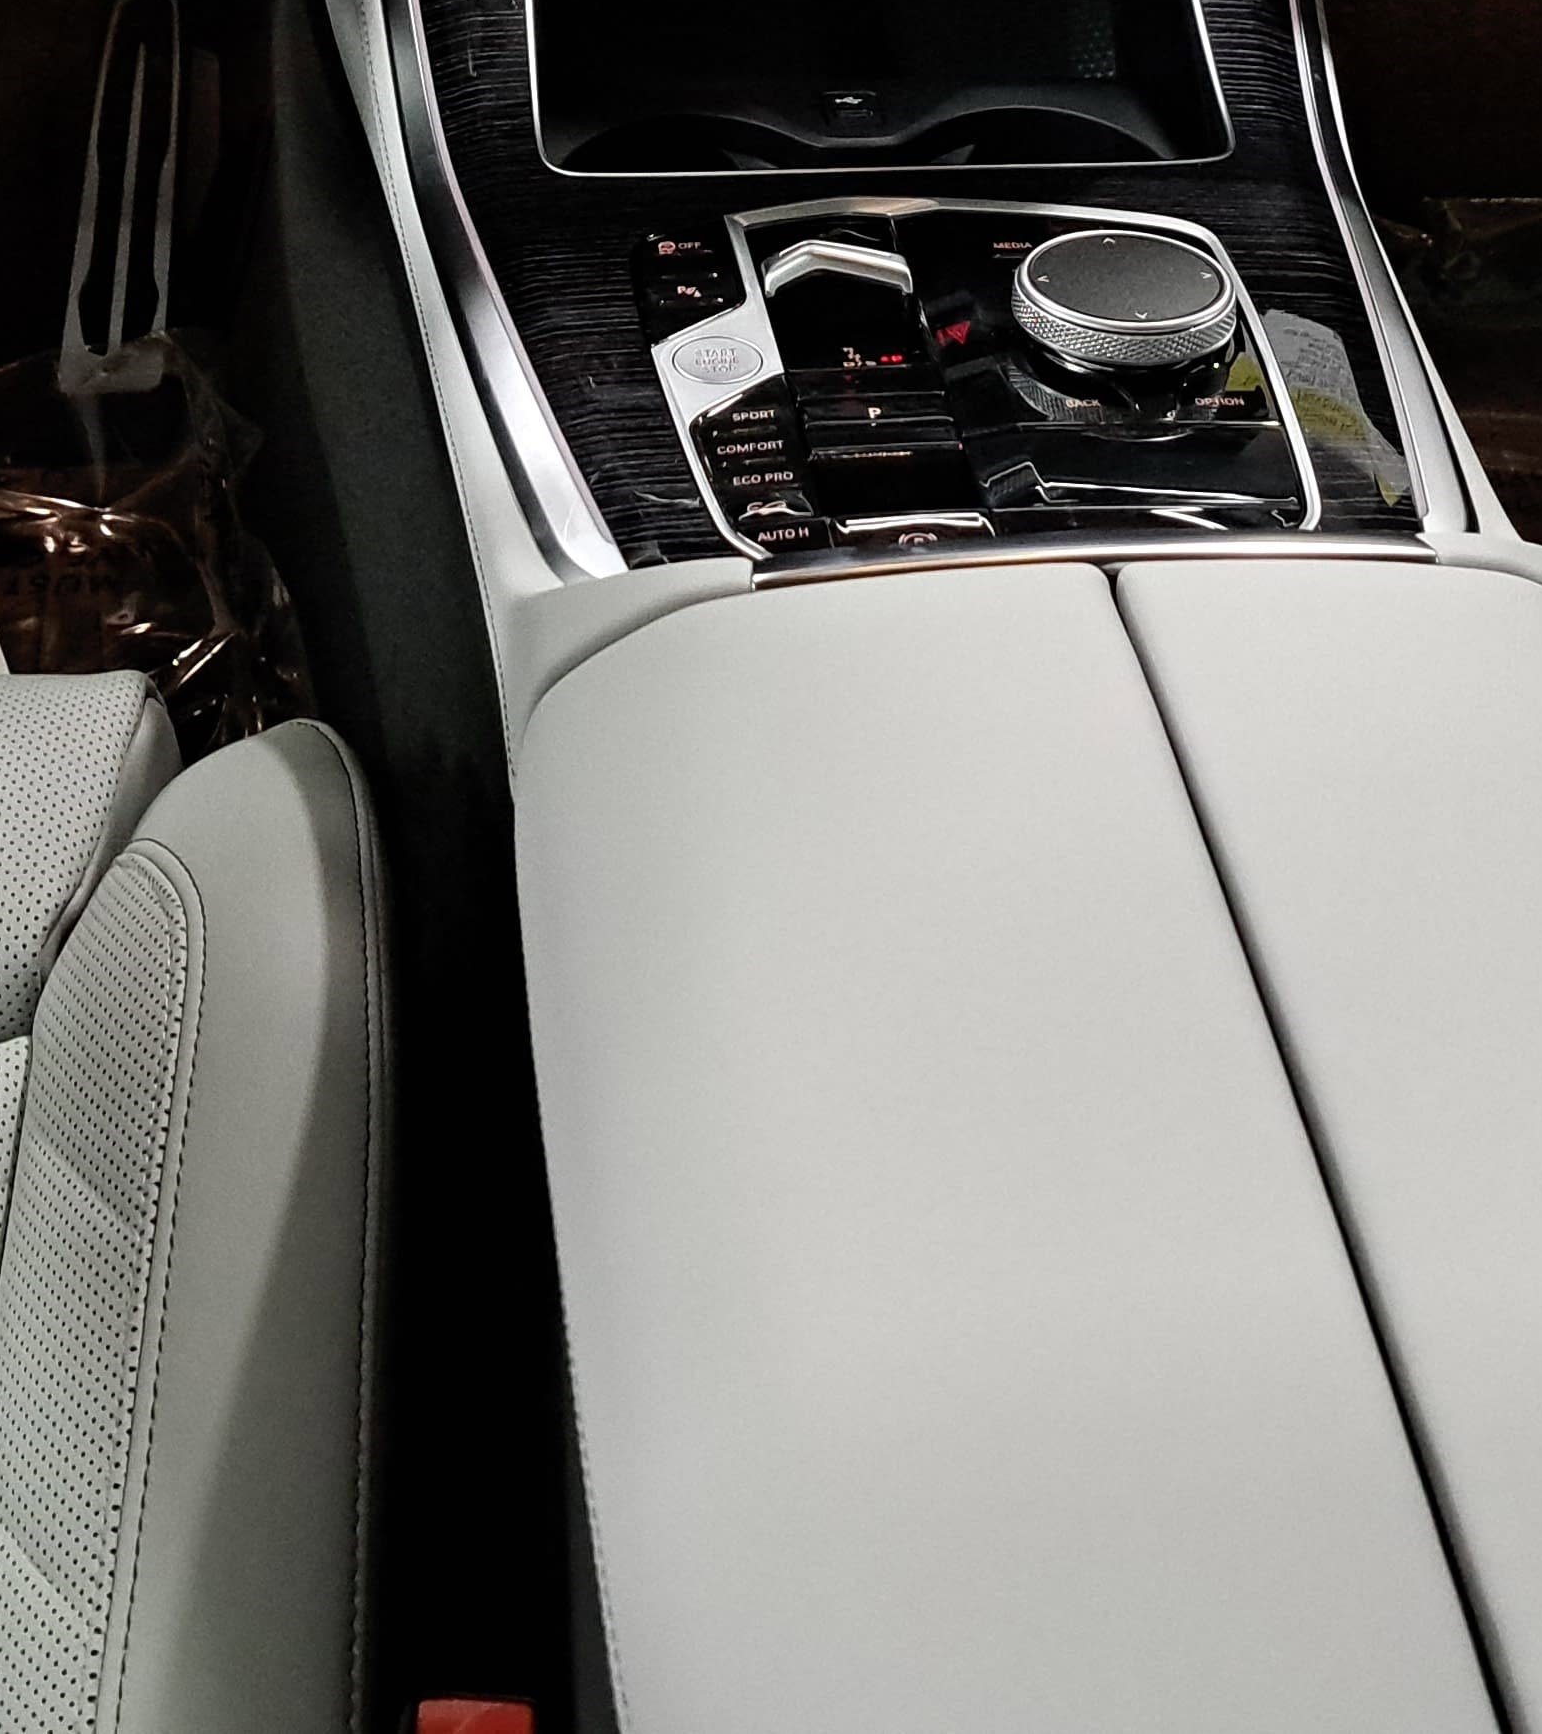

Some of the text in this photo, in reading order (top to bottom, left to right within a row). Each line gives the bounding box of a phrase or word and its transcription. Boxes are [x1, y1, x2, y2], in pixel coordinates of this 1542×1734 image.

[694, 347, 737, 357] START
[732, 409, 776, 422] SPORT
[717, 440, 784, 455] COMFORT
[733, 471, 793, 486] ECO PRO
[758, 526, 810, 542] AUTO H
